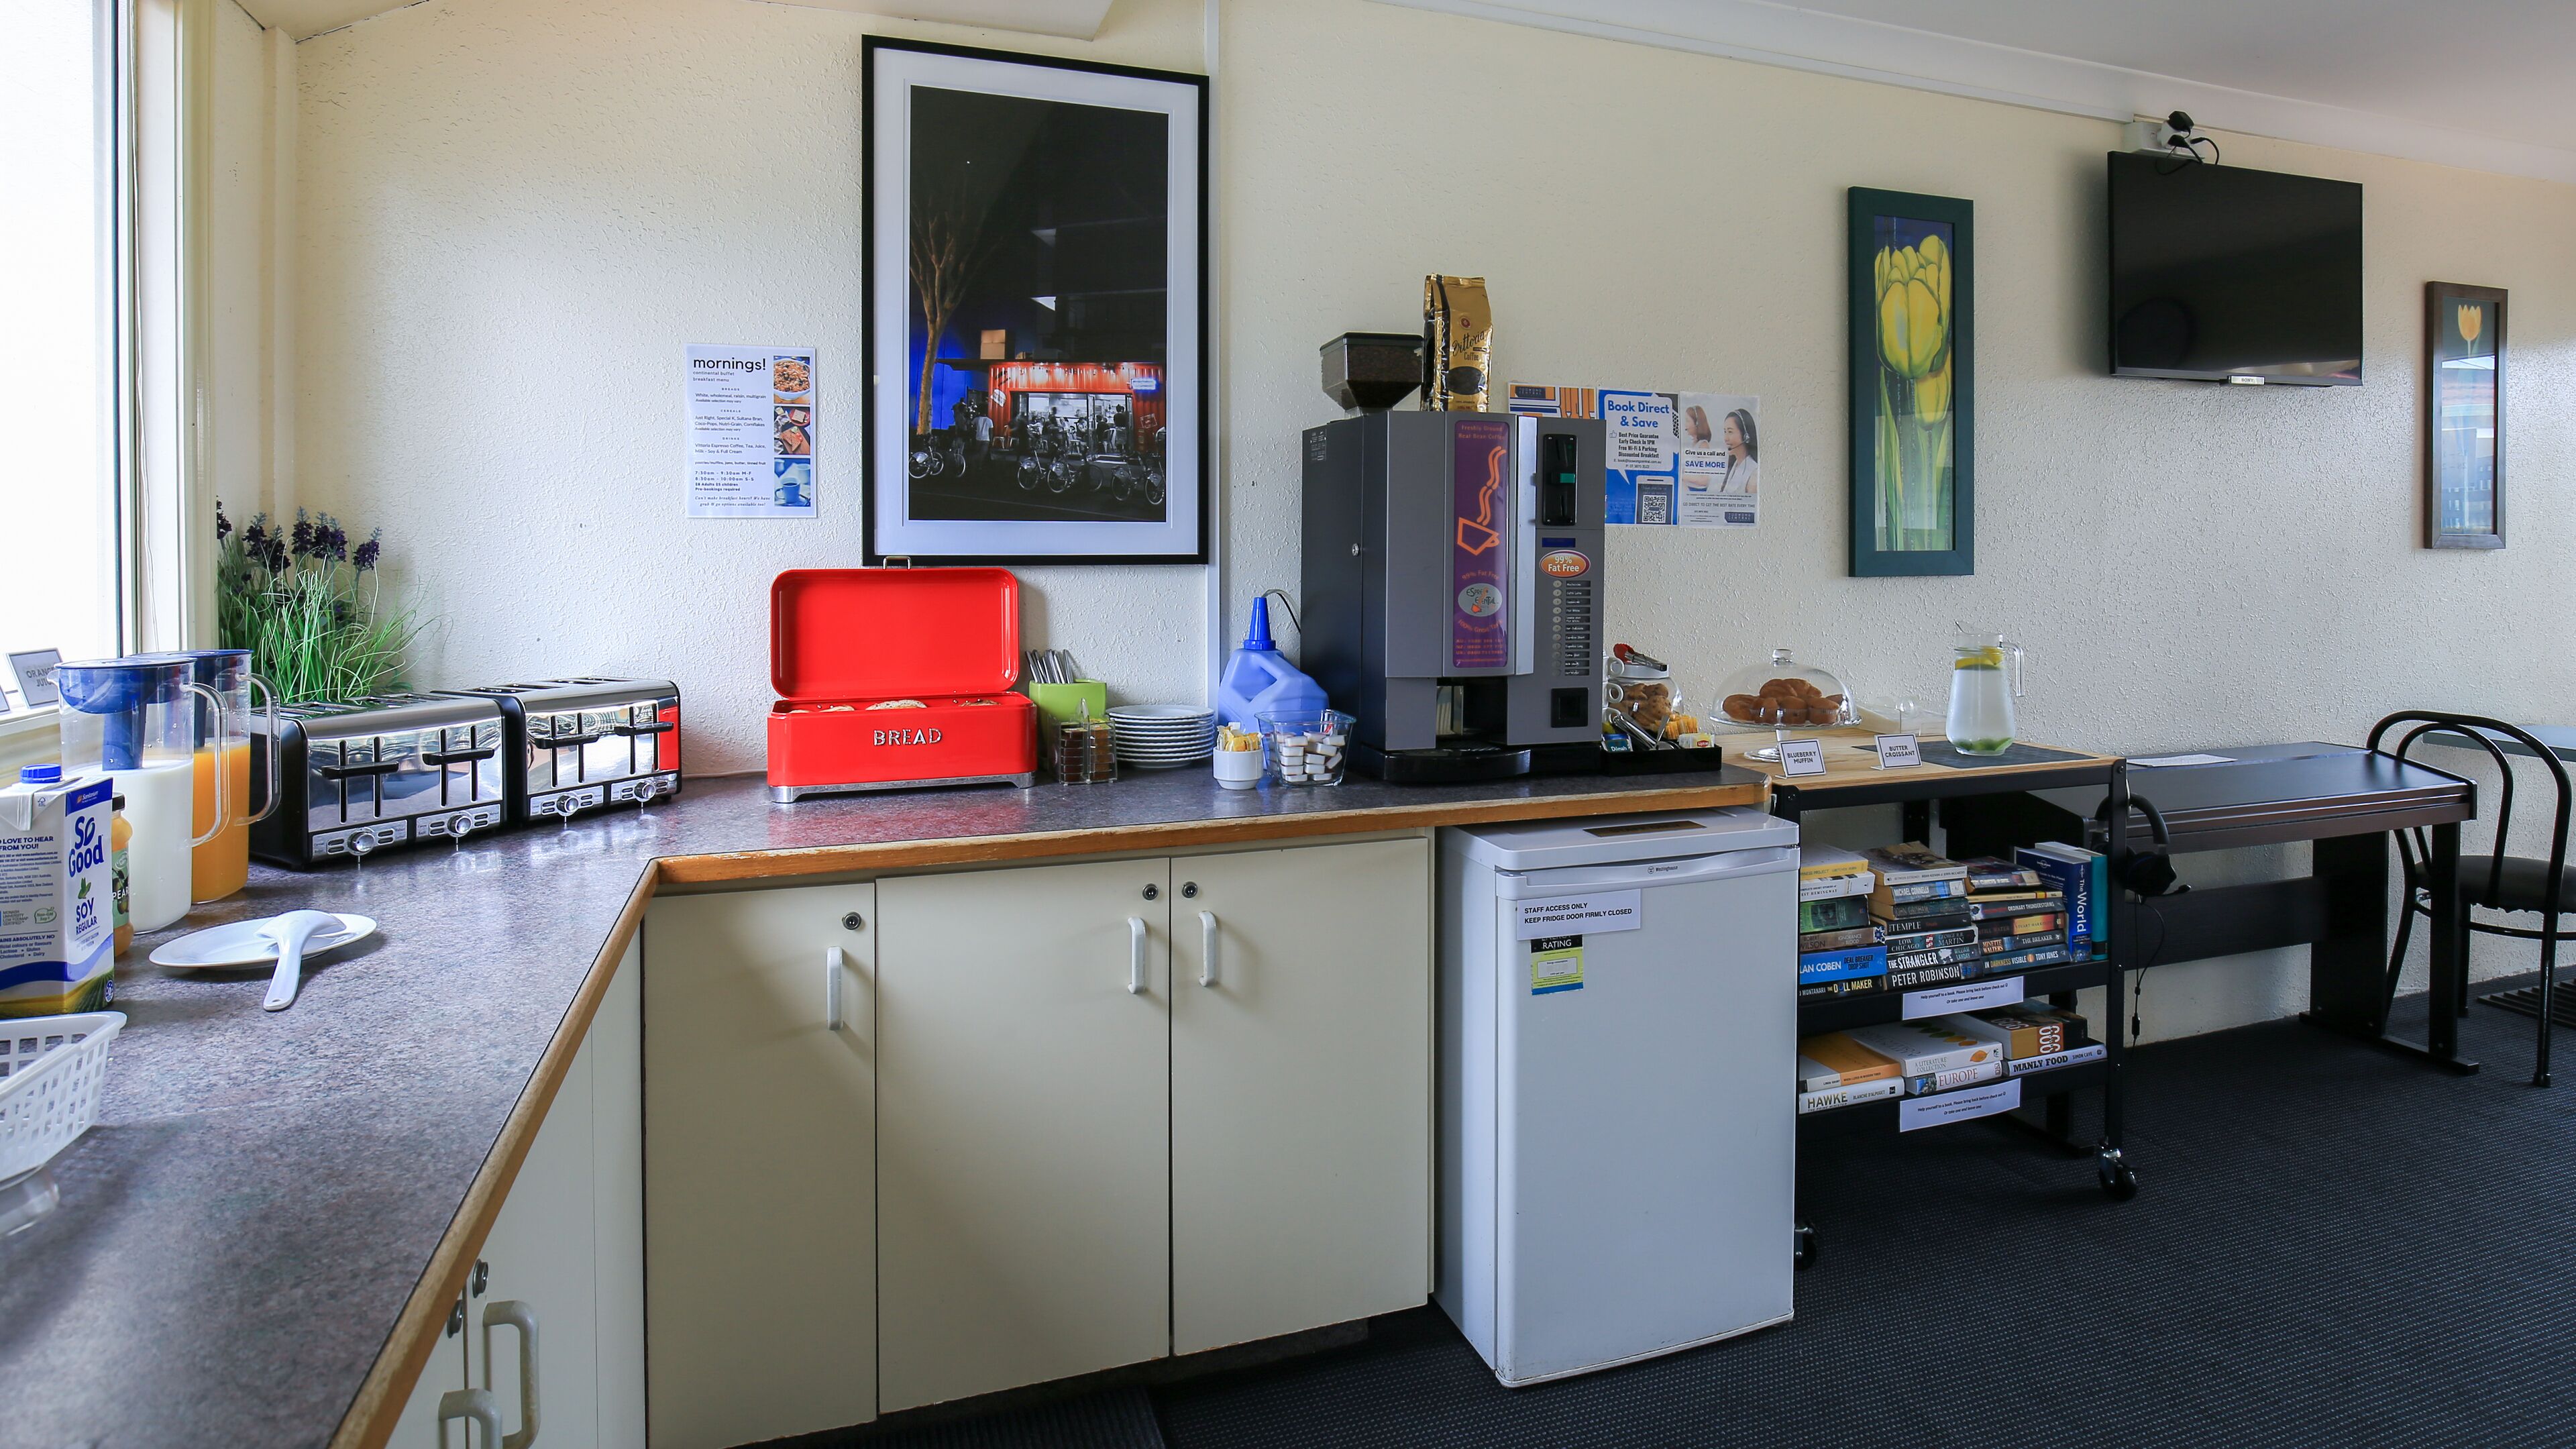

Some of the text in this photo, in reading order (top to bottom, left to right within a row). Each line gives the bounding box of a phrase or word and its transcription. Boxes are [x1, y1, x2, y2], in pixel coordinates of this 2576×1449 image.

[694, 358, 765, 372] mornings!
[1608, 400, 1669, 413] Book Direct
[1621, 416, 1658, 427] & Save
[1555, 555, 1572, 564] 99%
[874, 728, 942, 745] BREAD
[69, 835, 104, 877] Good
[1894, 886, 1929, 896] MICHAEL CONNELLY
[76, 898, 94, 922] SOY
[2077, 892, 2086, 932] World
[76, 916, 97, 935] REGULAR
[1543, 940, 1571, 949] RATING
[1939, 937, 1964, 946] MARTIN
[1816, 961, 1841, 971] COBEN
[1888, 953, 1938, 969] THE STRANGLER
[1990, 959, 2010, 967] DARKNESS
[2012, 956, 2027, 964] VISIBLE
[1892, 966, 1960, 987] PETER ROBINSON
[1851, 979, 1872, 990] MAKER
[1803, 987, 1825, 996] MONTANARI
[1920, 1057, 1947, 1066] LITERATURE
[2013, 1055, 2068, 1073] MANLY FOOD
[1917, 1064, 1946, 1073] COLLECTION
[1939, 1068, 1978, 1087] EUROPE
[1807, 1091, 1847, 1108] HAWKE
